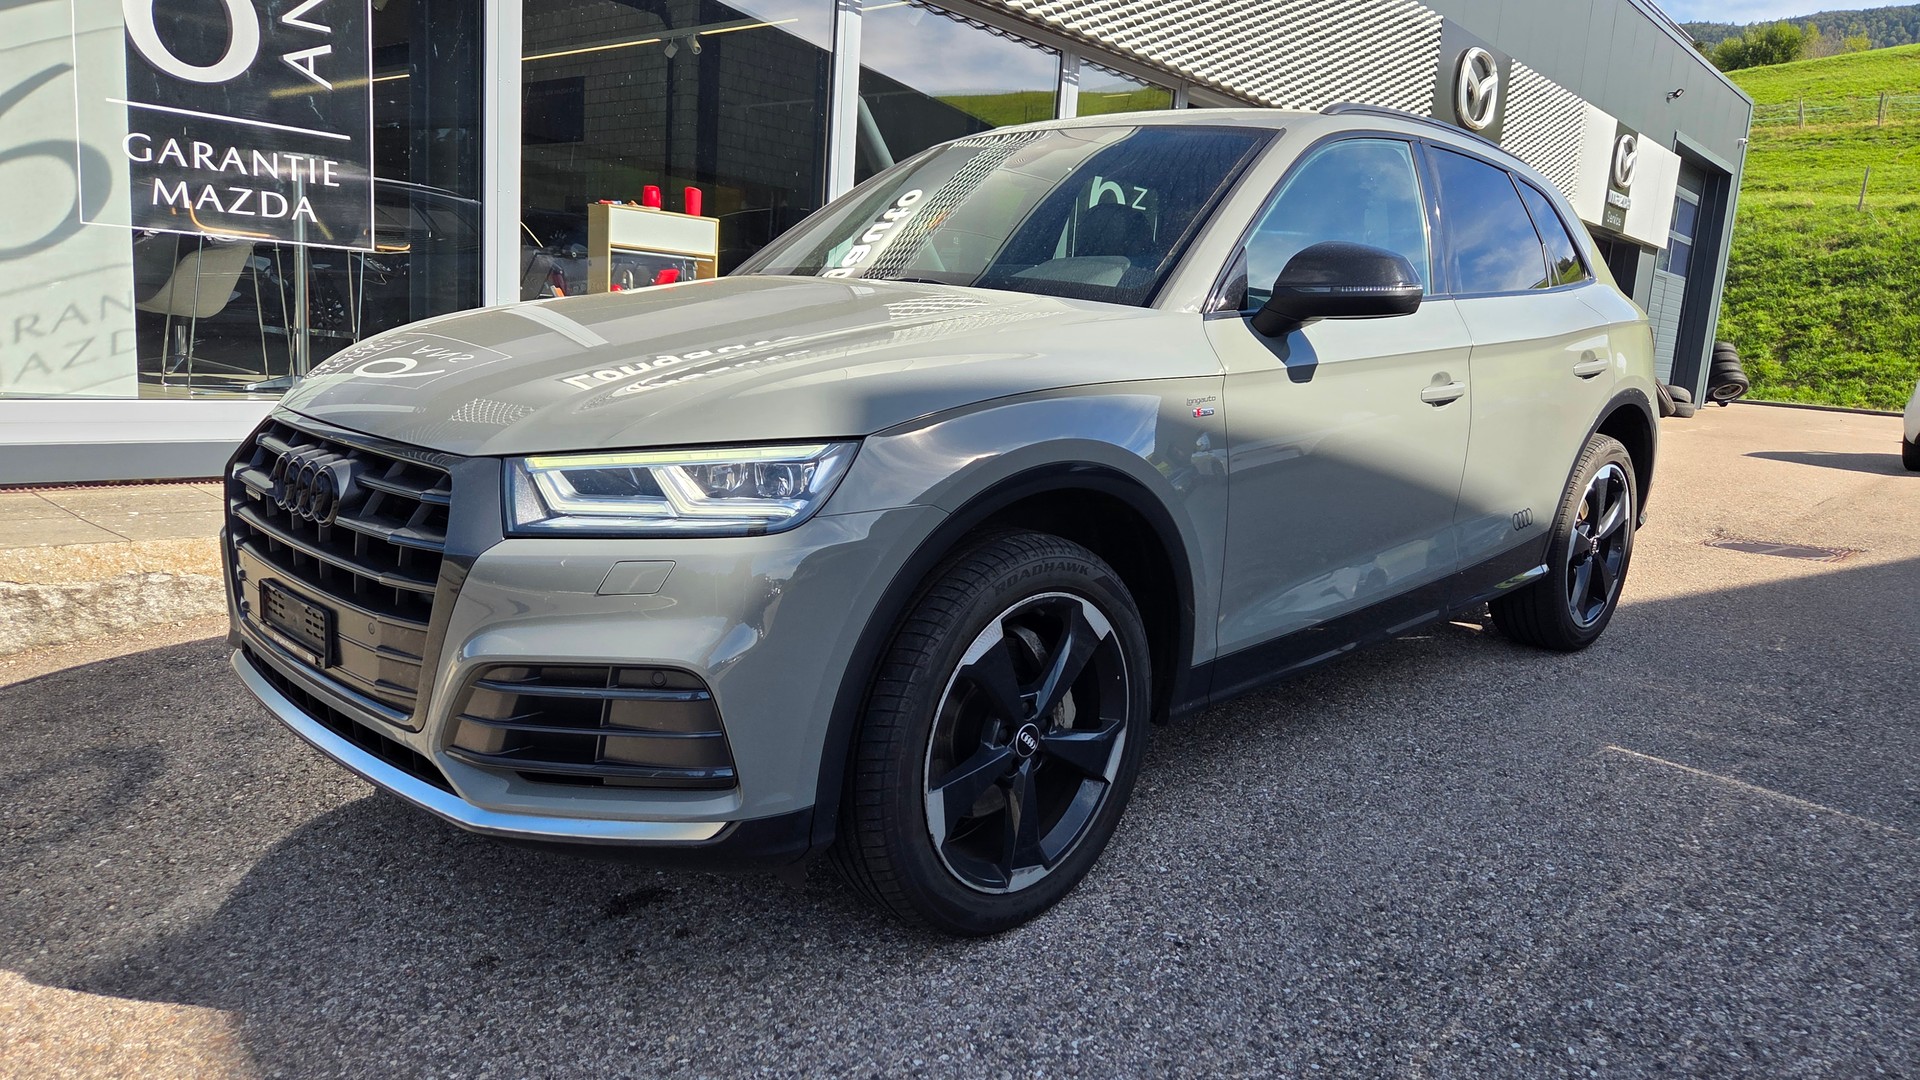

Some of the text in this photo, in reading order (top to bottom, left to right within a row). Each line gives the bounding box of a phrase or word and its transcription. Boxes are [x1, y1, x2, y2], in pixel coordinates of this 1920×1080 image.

[122, 132, 341, 188] GARANTIE
[152, 178, 319, 223] MAZDA
[995, 562, 1089, 596] ROADHAWK
